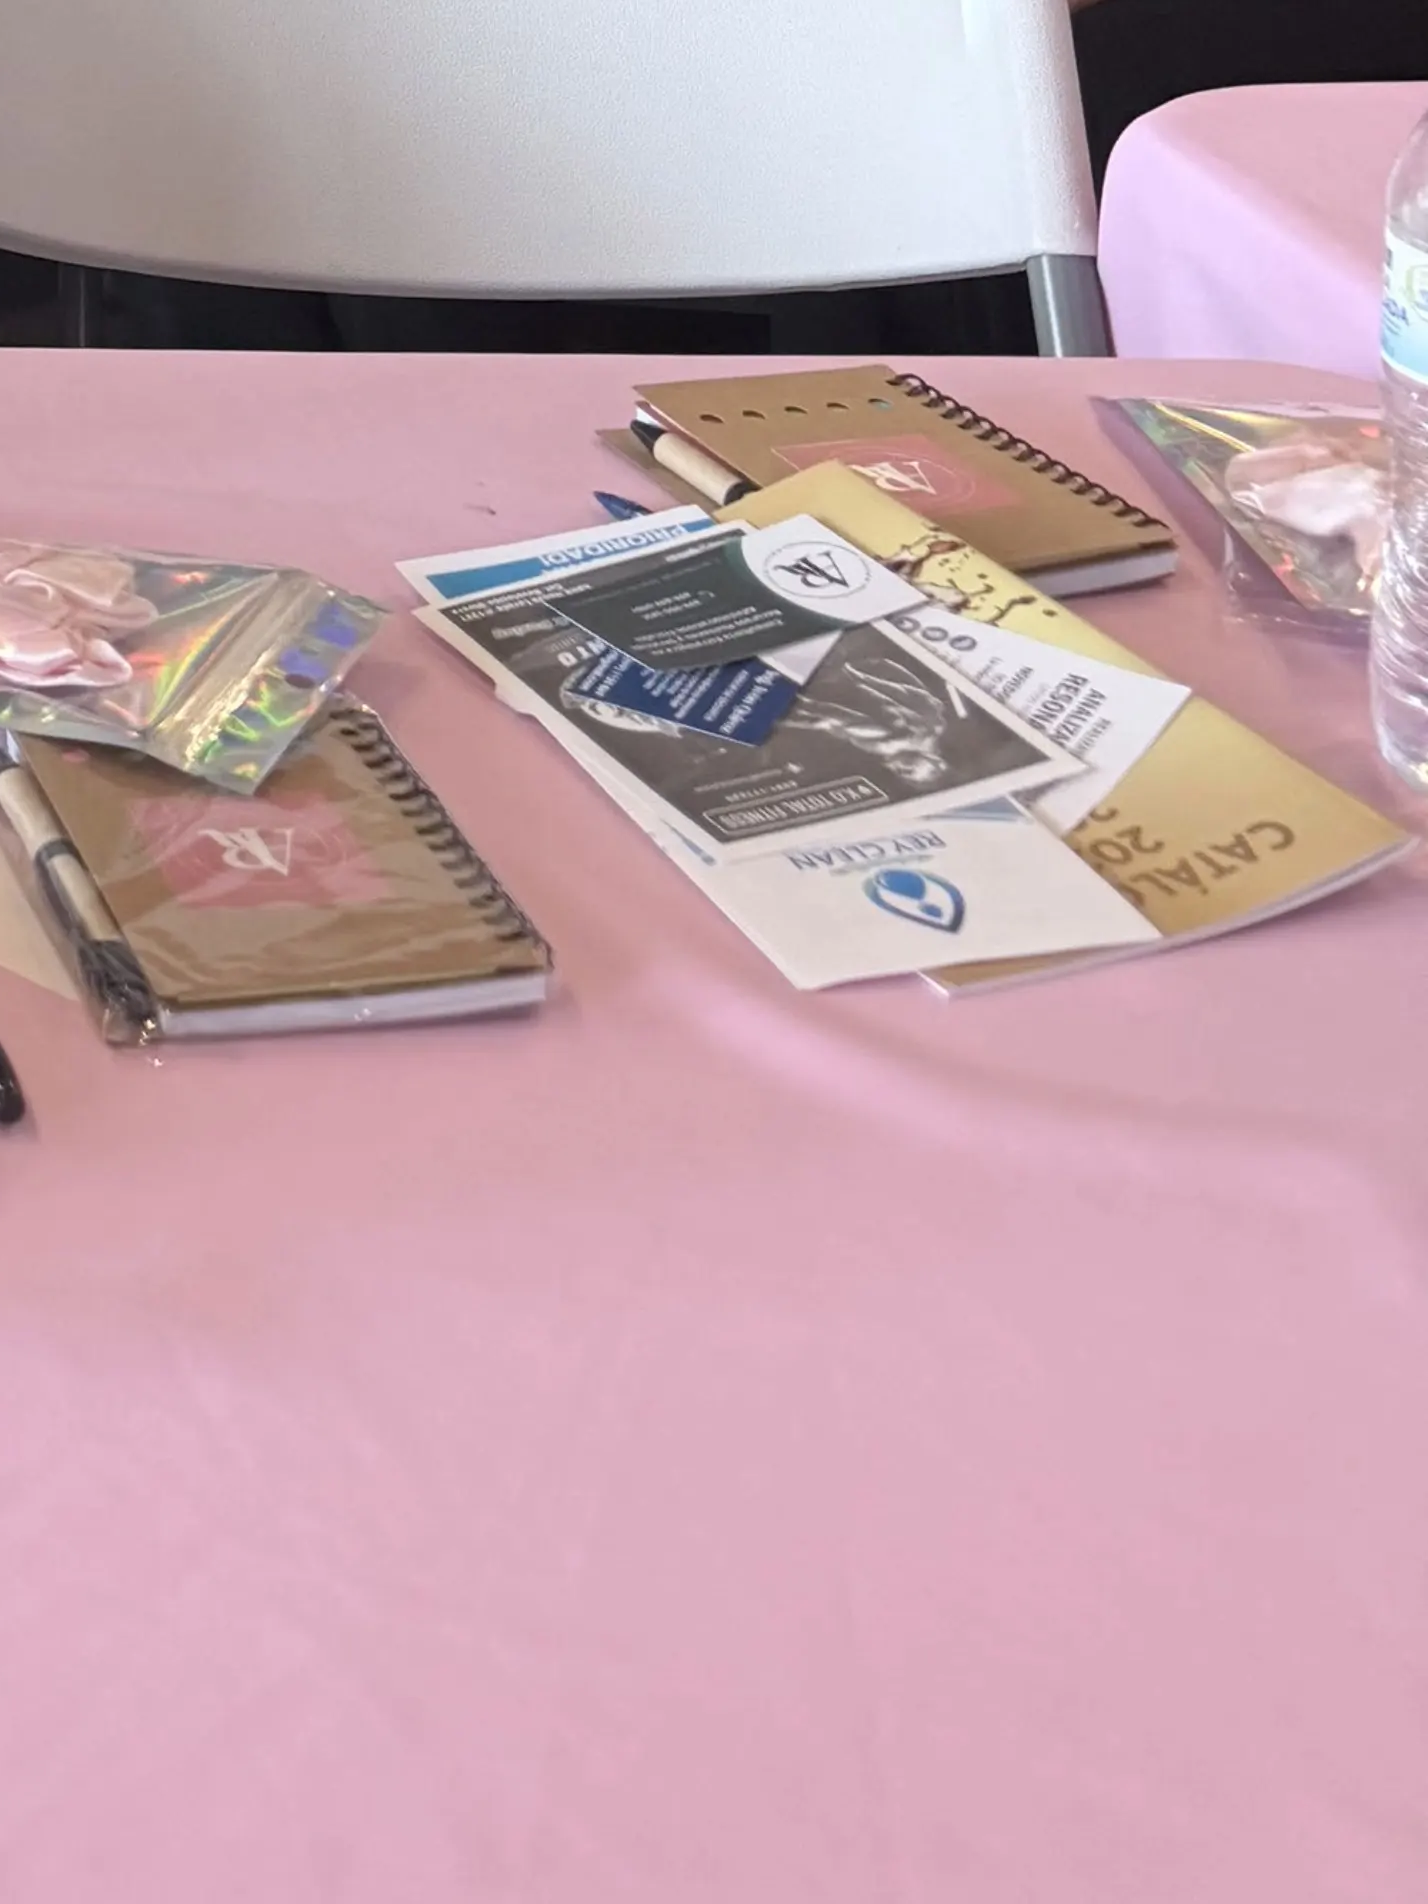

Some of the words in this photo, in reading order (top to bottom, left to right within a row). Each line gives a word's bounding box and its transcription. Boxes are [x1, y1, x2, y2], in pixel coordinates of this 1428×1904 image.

[787, 794, 831, 815] TOTAL
[895, 828, 947, 855] REY
[787, 841, 887, 872] CLEAN
